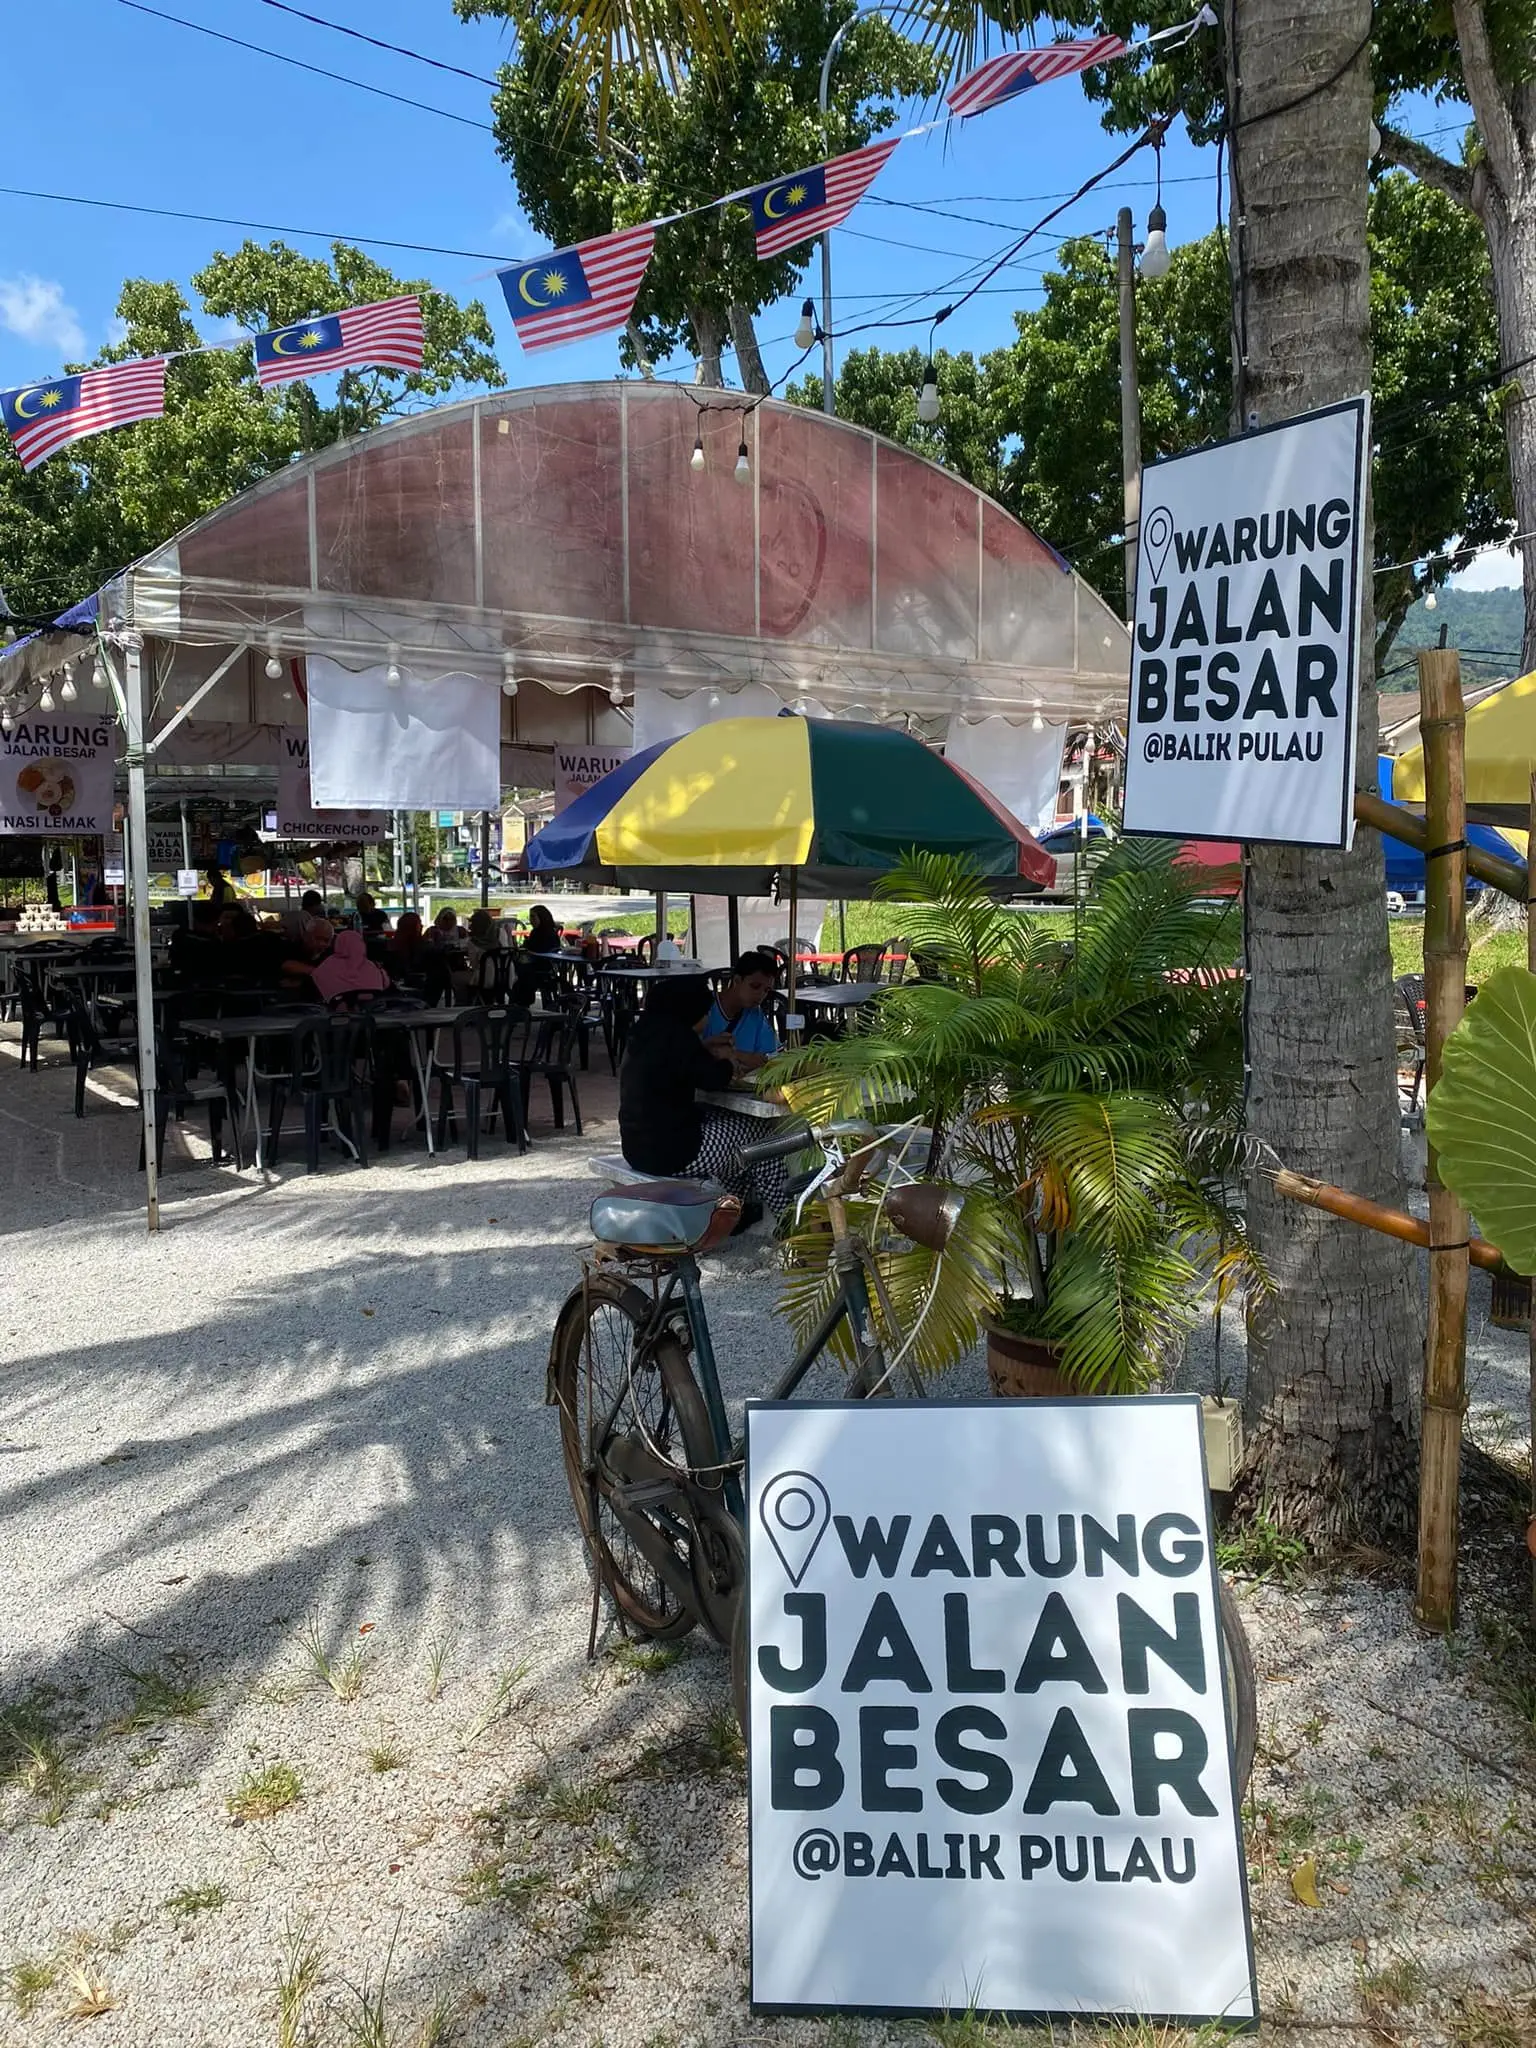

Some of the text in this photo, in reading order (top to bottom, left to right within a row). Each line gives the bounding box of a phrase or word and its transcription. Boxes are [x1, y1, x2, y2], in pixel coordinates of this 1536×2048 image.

[1174, 498, 1351, 574] WARUNG
[1137, 558, 1344, 652] JALAN
[1137, 644, 1338, 723] BESAR
[4, 744, 96, 759] JALAN BESAR
[1144, 731, 1323, 763] @BALIK PULAU
[4, 815, 97, 829] NASI LEMAK
[282, 822, 380, 836] CHICKENCHOP
[833, 1512, 1205, 1579] WARUNG
[757, 1591, 1207, 1695] JALAN
[770, 1705, 1219, 1817] BESAR
[793, 1828, 1197, 1883] @BALIK PULAU
